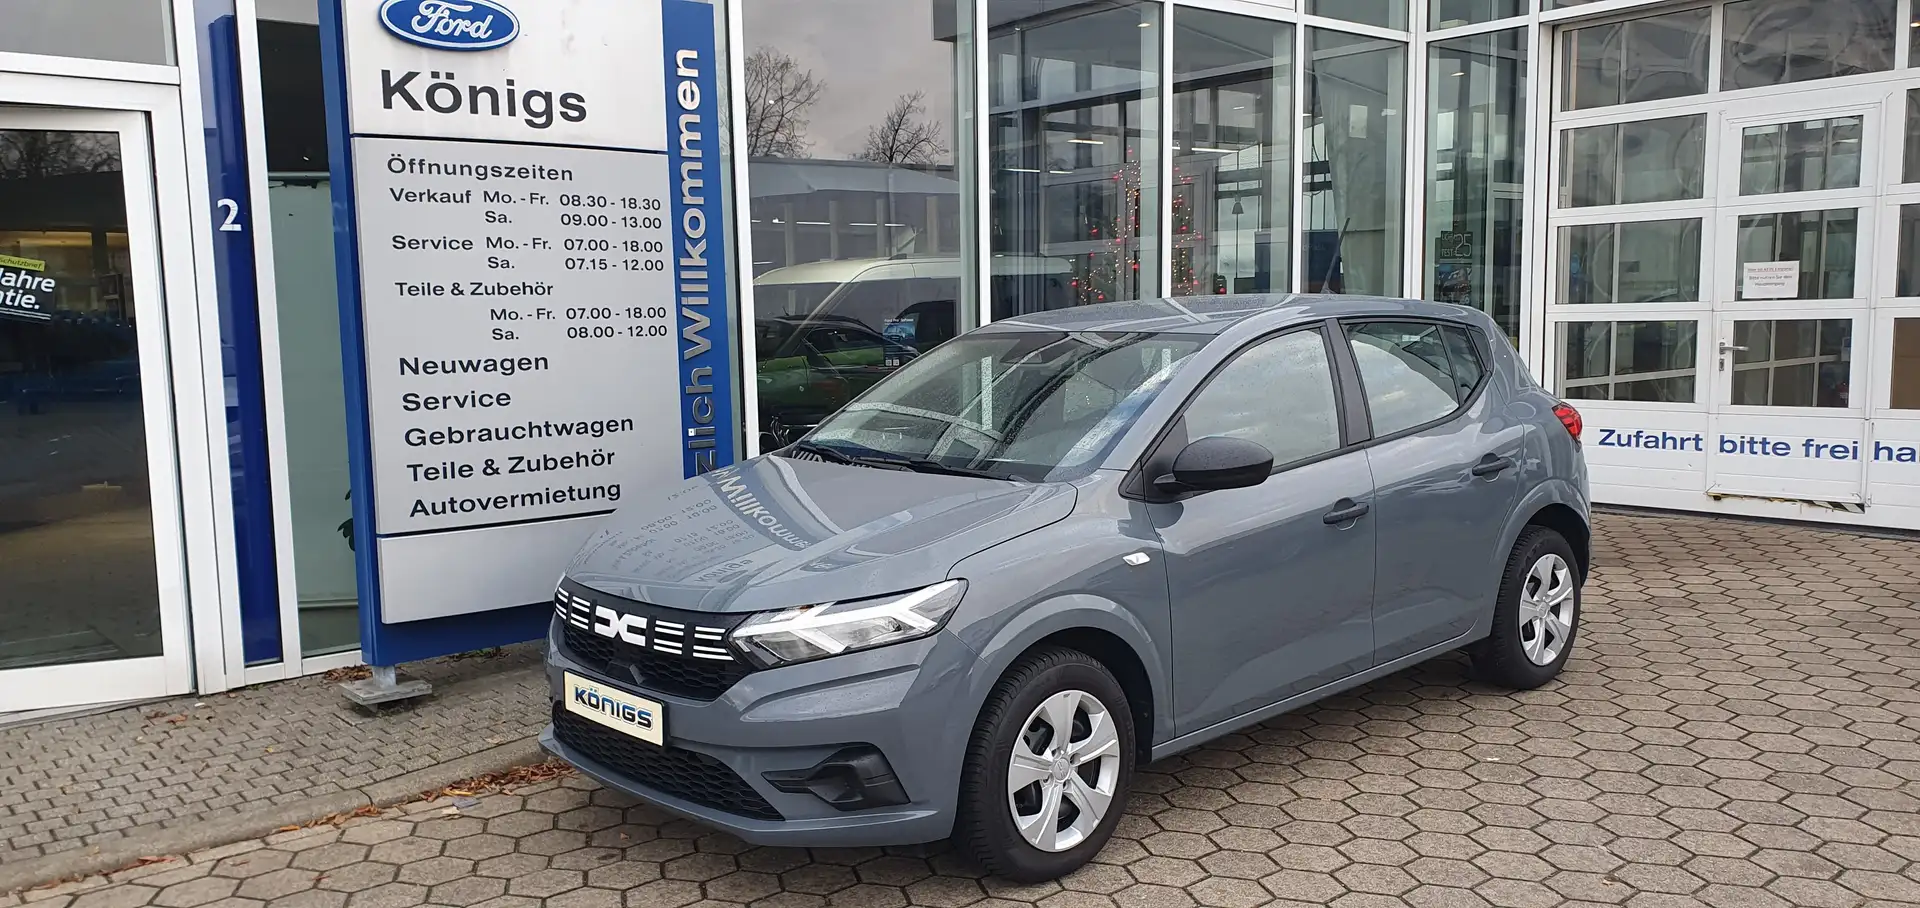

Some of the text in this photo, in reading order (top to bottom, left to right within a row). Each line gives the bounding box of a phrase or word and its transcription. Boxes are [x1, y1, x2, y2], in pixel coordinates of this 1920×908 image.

[411, 0, 494, 39] Ford
[381, 69, 587, 129] Königs
[387, 153, 573, 182] Öffnungszeiten
[389, 187, 472, 204] Verkauf
[483, 190, 517, 204] Mo.
[529, 192, 549, 206] Fr.
[559, 193, 607, 208] 08.30
[620, 197, 661, 211] 18.30
[676, 49, 712, 360] Willkommen
[217, 199, 242, 231] 2
[484, 210, 513, 224] Sa.
[560, 213, 609, 227] 09.00
[621, 215, 662, 230] 13.00
[391, 234, 474, 251] Service
[485, 236, 519, 250] Mo.
[532, 237, 552, 250] Fr.
[563, 238, 609, 252] 07.00
[622, 240, 663, 253] 18.00
[487, 256, 515, 269] Sa.
[564, 257, 608, 271] 07.15
[622, 258, 664, 272] 12.00
[395, 281, 554, 297] Teile & Zubehör
[490, 308, 524, 321] Mo.
[536, 307, 556, 320] Fr.
[565, 307, 612, 320] 07.00
[624, 306, 667, 319] 18.00
[491, 327, 519, 341] Sa.
[566, 326, 615, 339] 08.00
[627, 324, 668, 338] 12.00
[399, 356, 549, 377] Neuwagen
[402, 390, 512, 412] Service
[404, 417, 634, 447] Gebrauchtwagen
[1598, 428, 1917, 462] Zufahrt bitte frei ha
[406, 448, 616, 482] Teile & Zubehör
[409, 483, 622, 518] Autovermietung
[574, 686, 653, 729] KÖNIGS
